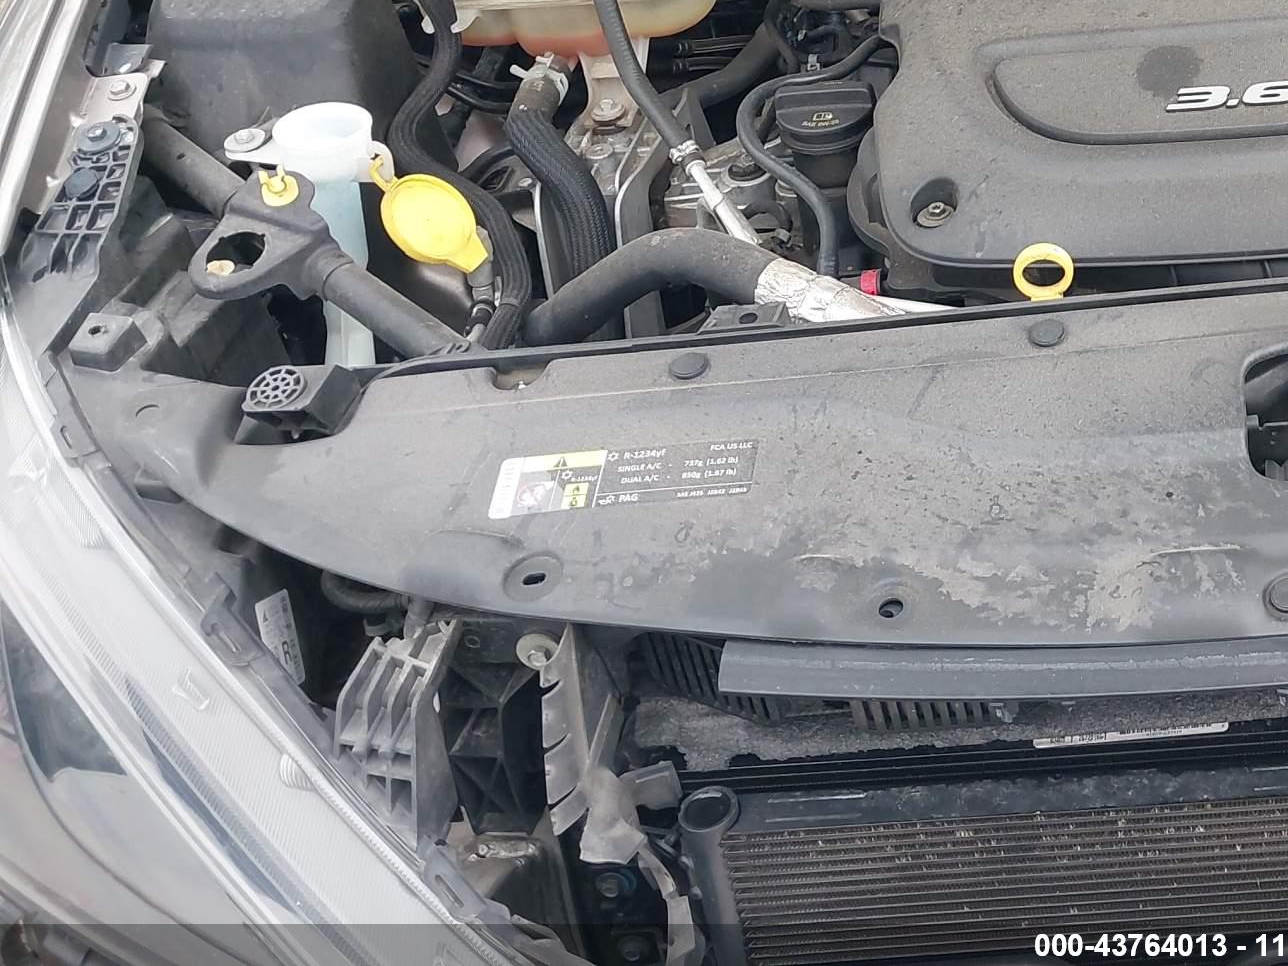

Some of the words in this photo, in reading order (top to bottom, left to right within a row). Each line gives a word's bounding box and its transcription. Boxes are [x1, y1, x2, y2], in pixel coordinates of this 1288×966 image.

[710, 443, 726, 451] FCA
[727, 442, 738, 450] US
[739, 441, 753, 449] LLC
[623, 448, 666, 460] R-1234yf
[617, 463, 645, 473] SINGLE
[646, 462, 662, 470] A/C
[620, 475, 643, 484] DUAL
[643, 474, 660, 482] A/C
[618, 493, 639, 503] PAG
